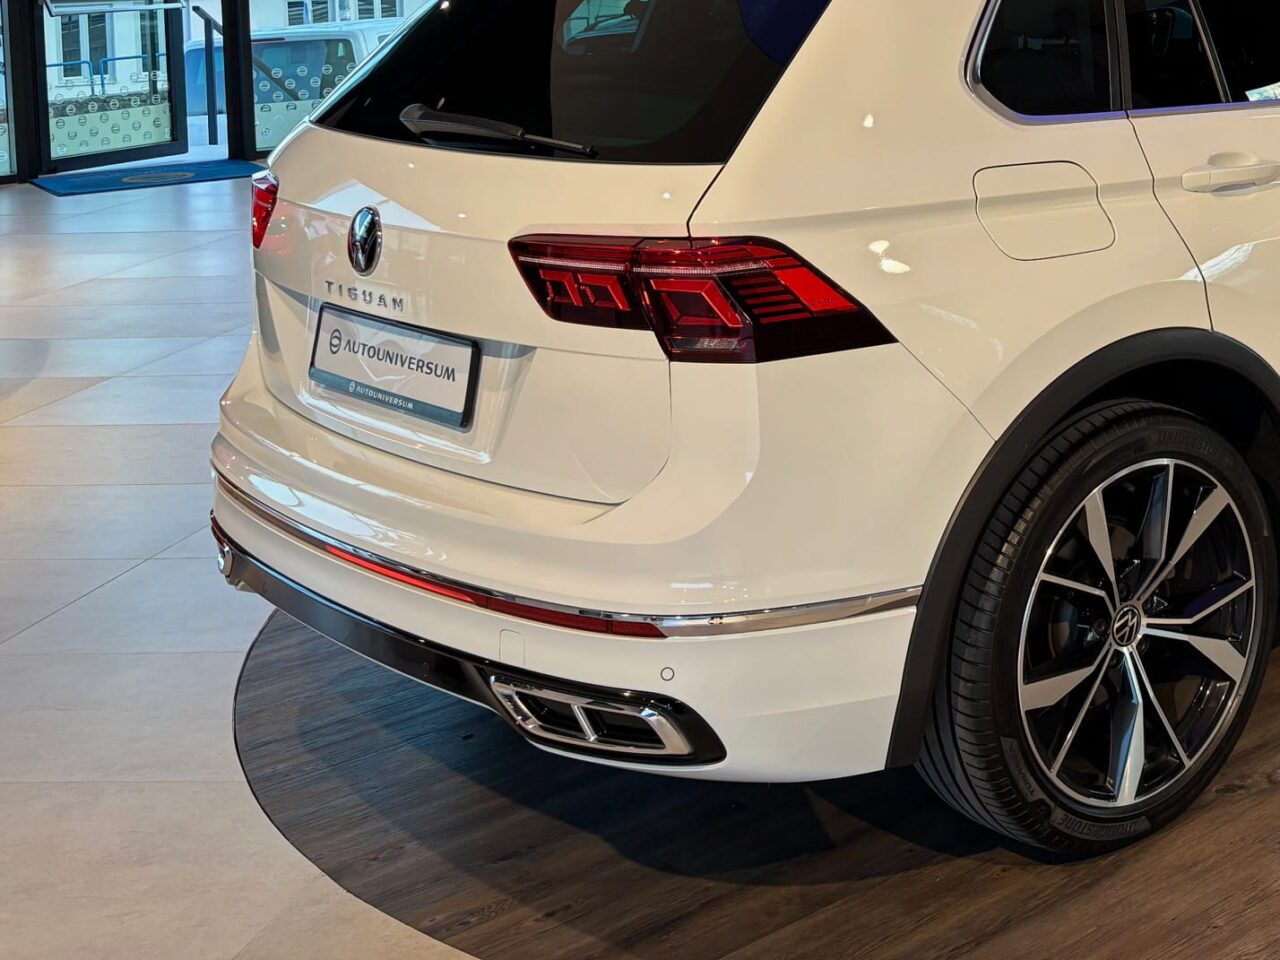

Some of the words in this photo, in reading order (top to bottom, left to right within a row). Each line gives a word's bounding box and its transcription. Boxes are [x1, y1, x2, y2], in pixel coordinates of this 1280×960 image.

[325, 280, 404, 311] TIGUAN
[344, 339, 456, 382] AUTOUNIVERSUM
[356, 385, 414, 409] AUTOUNIVERSUM
